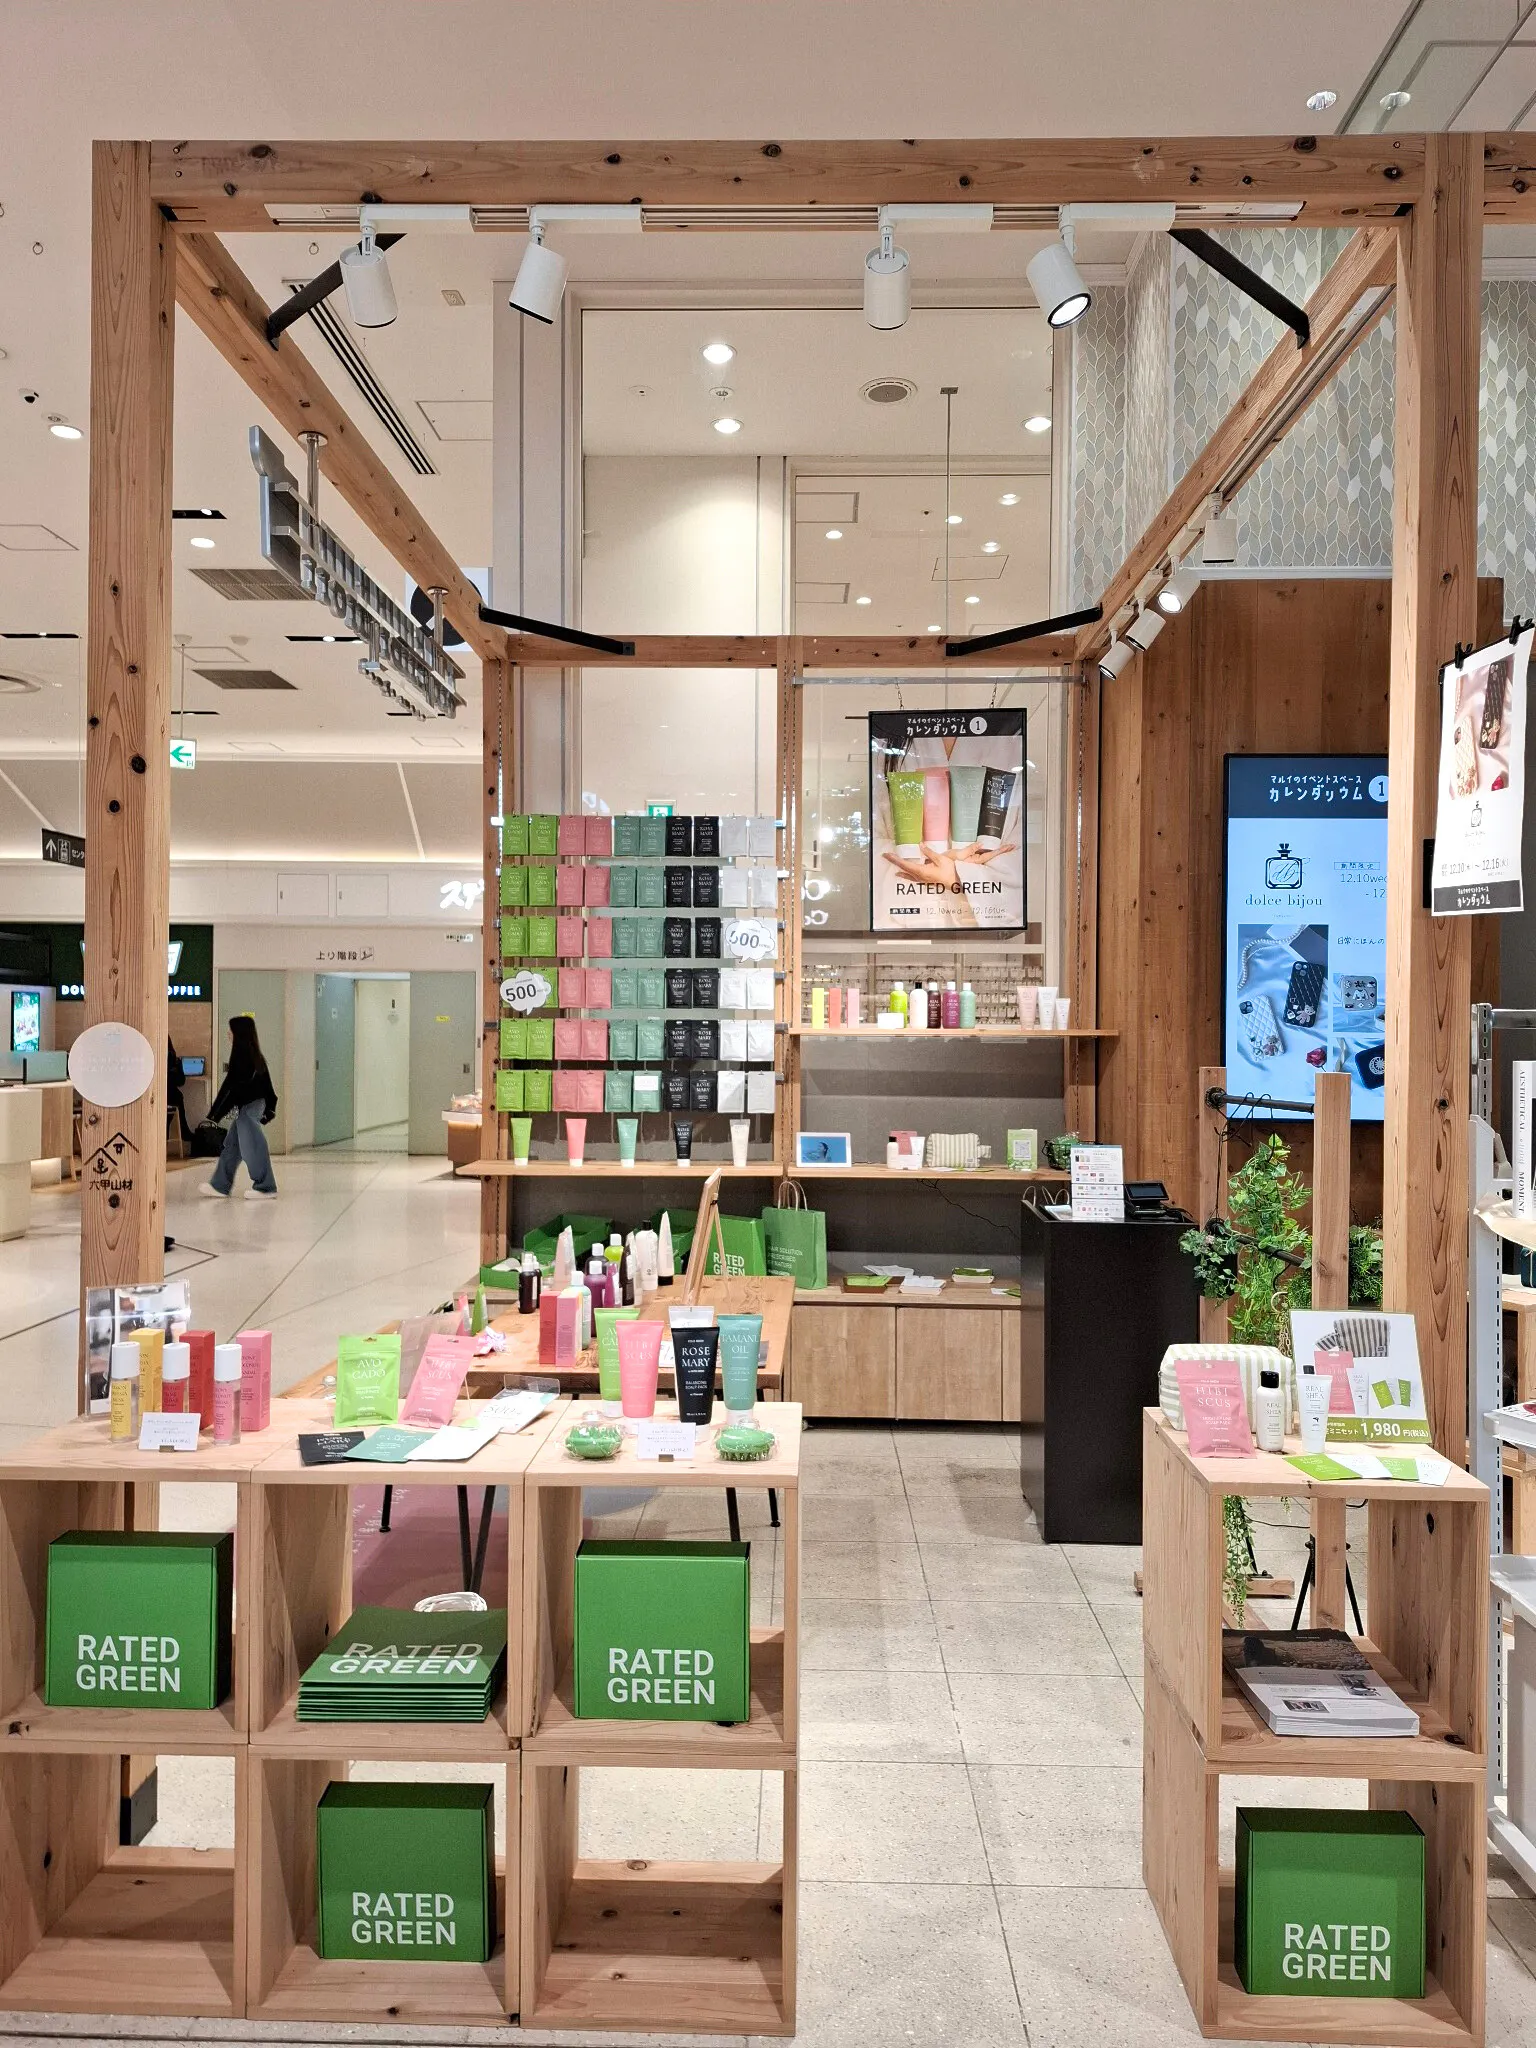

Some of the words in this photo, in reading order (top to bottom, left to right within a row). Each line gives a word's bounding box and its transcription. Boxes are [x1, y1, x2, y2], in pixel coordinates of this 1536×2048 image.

[907, 725, 966, 736] カレンダリウム
[976, 721, 981, 730] 1
[1270, 775, 1362, 784] マルイのイベントスペース
[1269, 785, 1362, 802] カレンダリウム
[1378, 781, 1384, 796] 1
[897, 883, 945, 895] RATED
[951, 882, 1002, 894] GREEN
[1246, 894, 1281, 905] dolce
[1288, 894, 1322, 908] bijou
[316, 951, 357, 960] 上り階段
[506, 984, 536, 1001] 500
[89, 1179, 133, 1191] 六甲山材
[682, 1347, 710, 1356] ROSE
[732, 1345, 749, 1353] OIL
[357, 1359, 382, 1368] AVO
[682, 1358, 711, 1367] MARY
[352, 1369, 386, 1379] CADO
[1195, 1387, 1228, 1396] HIBI
[1198, 1398, 1231, 1408] SCUS
[1361, 1422, 1400, 1438] 1,980
[77, 1634, 181, 1663] RATED
[342, 1643, 484, 1659] RATED
[329, 1659, 478, 1675] GREEN
[607, 1647, 715, 1676] RATED
[75, 1664, 182, 1693] GREEN
[606, 1677, 716, 1705] GREEN
[351, 1892, 455, 1918] RATED
[350, 1919, 457, 1945] GREEN
[1284, 1923, 1391, 1952] RATED
[1281, 1952, 1392, 1981] GREEN
